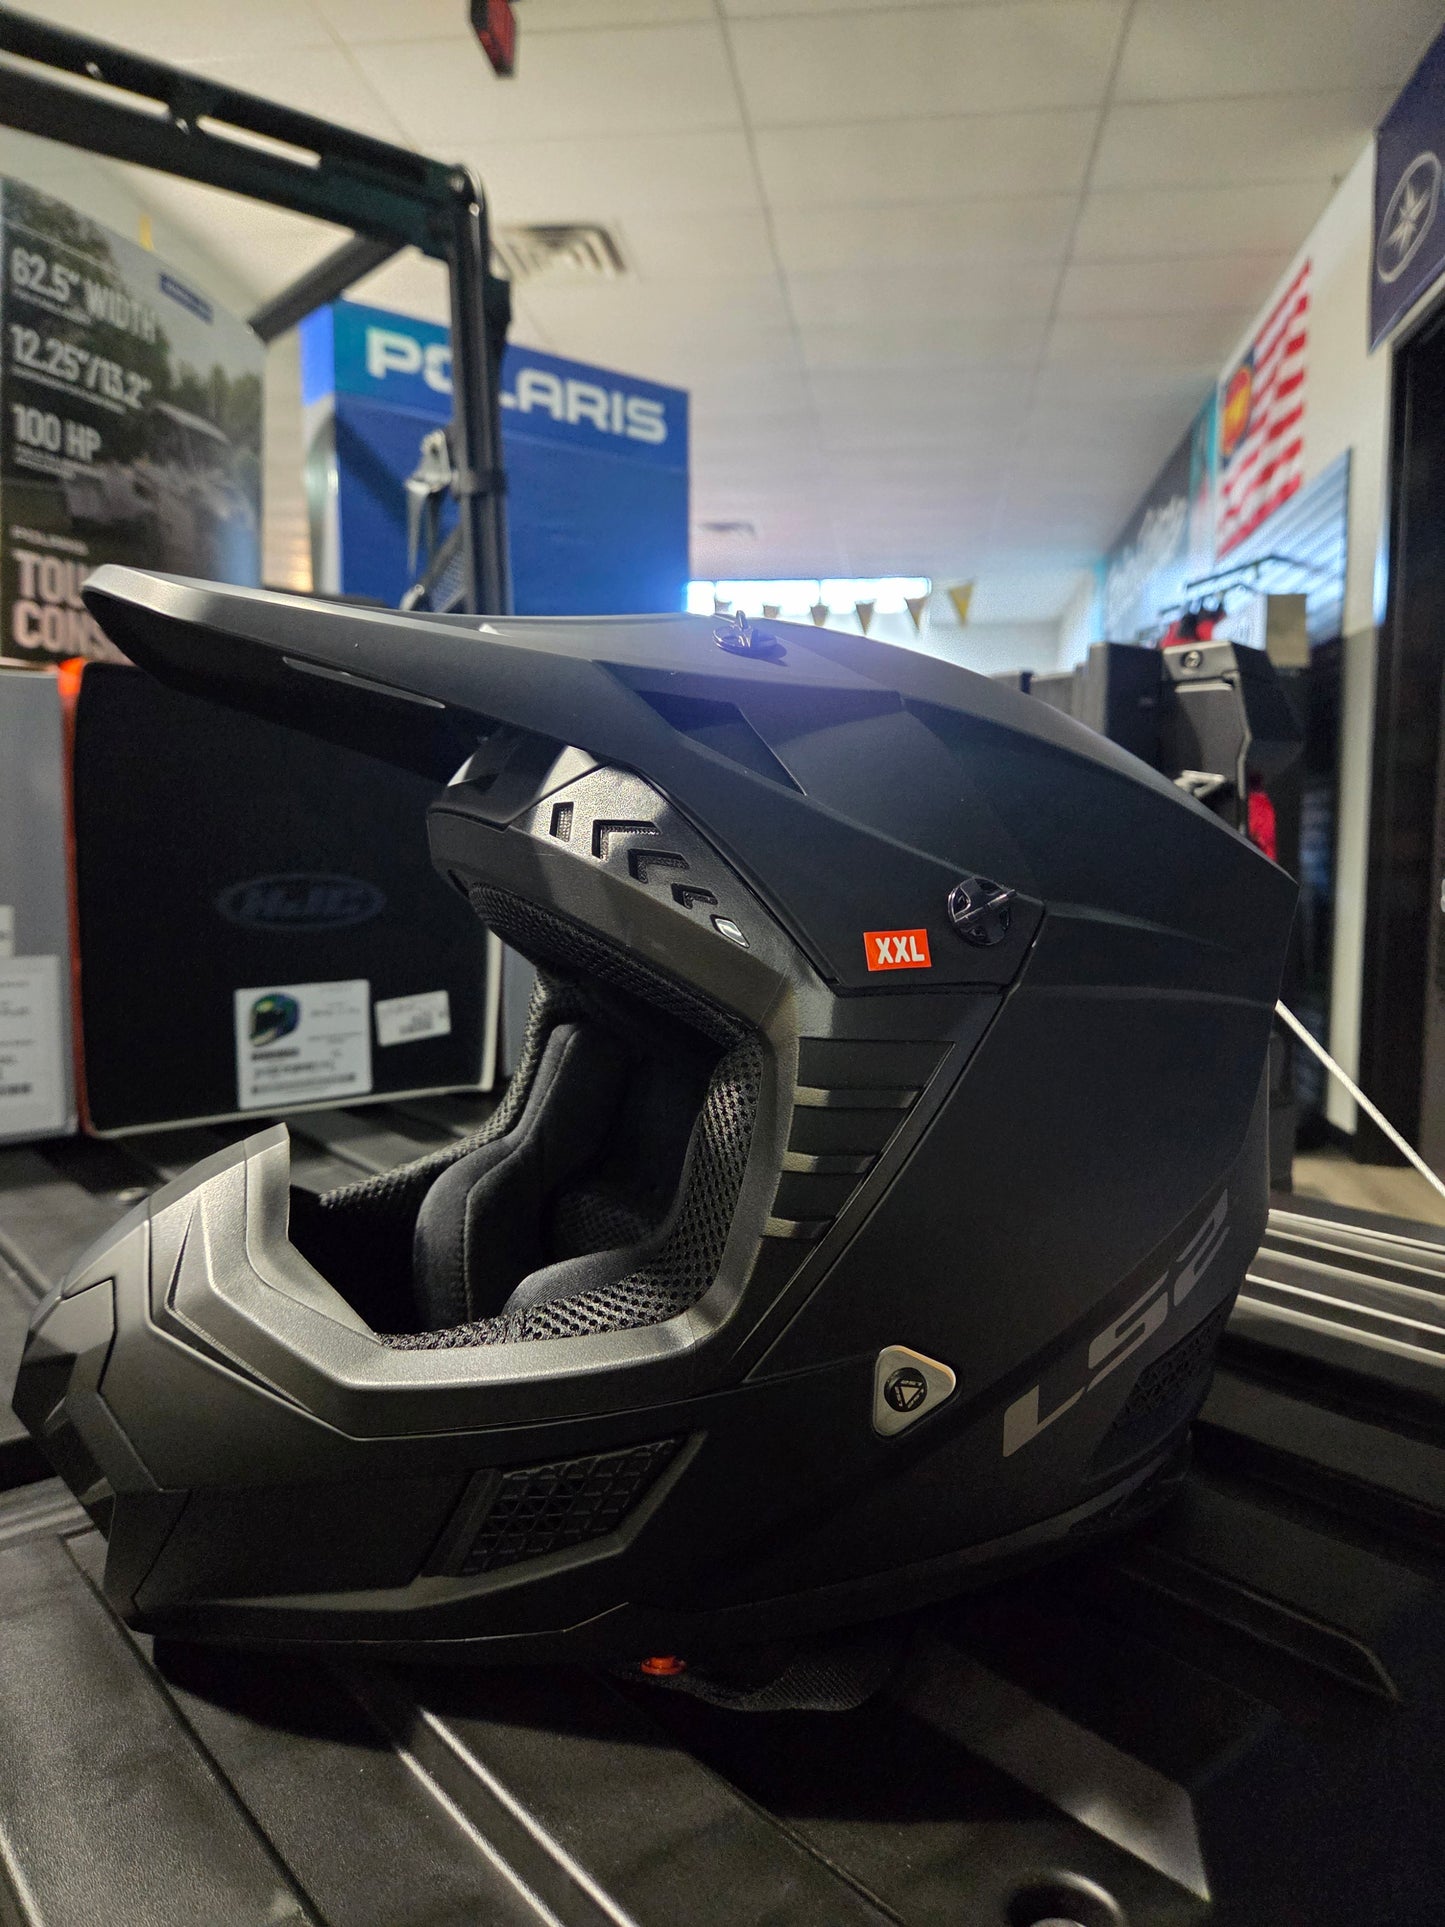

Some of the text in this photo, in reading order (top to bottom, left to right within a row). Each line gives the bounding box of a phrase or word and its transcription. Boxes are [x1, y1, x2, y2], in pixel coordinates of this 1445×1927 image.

[11, 247, 80, 302] 62.5"
[83, 278, 157, 344] WIDTH
[13, 403, 102, 461] 100 HP
[875, 935, 925, 965] XXL
[1003, 1188, 1230, 1457] LS2
